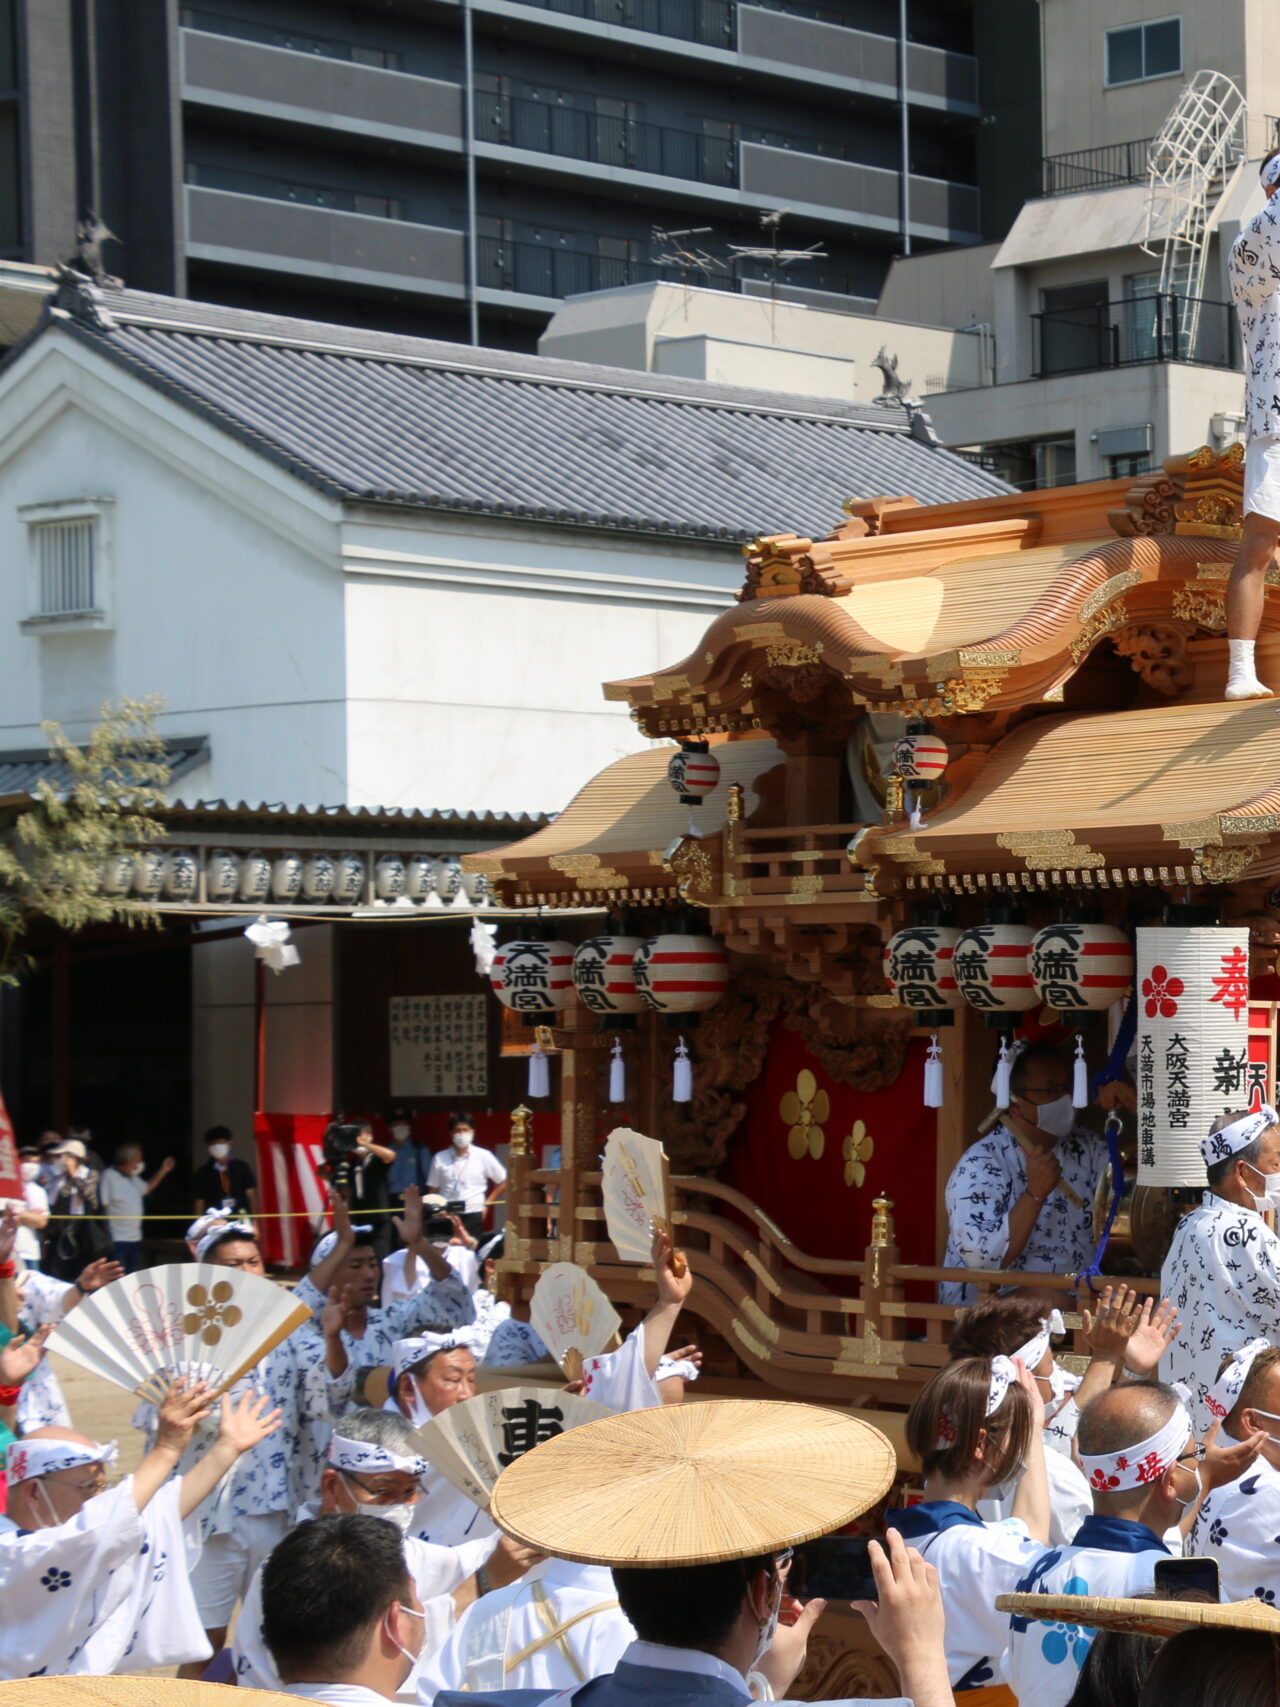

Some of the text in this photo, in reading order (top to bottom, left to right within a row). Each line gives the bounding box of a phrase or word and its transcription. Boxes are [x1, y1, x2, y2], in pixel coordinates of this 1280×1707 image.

[896, 736, 920, 776] 天満宮
[502, 943, 555, 1010] 天満宮
[574, 937, 618, 1010] 天満宮
[889, 928, 948, 1008] 天満宮
[954, 926, 1005, 1008] 天満宮
[1032, 925, 1088, 1008] 天満宮
[1208, 946, 1248, 1023] 奉
[1141, 1034, 1156, 1168] 天満市場地車講
[1165, 1033, 1192, 1129] 大阪天満宮
[1135, 1451, 1167, 1484] 場
